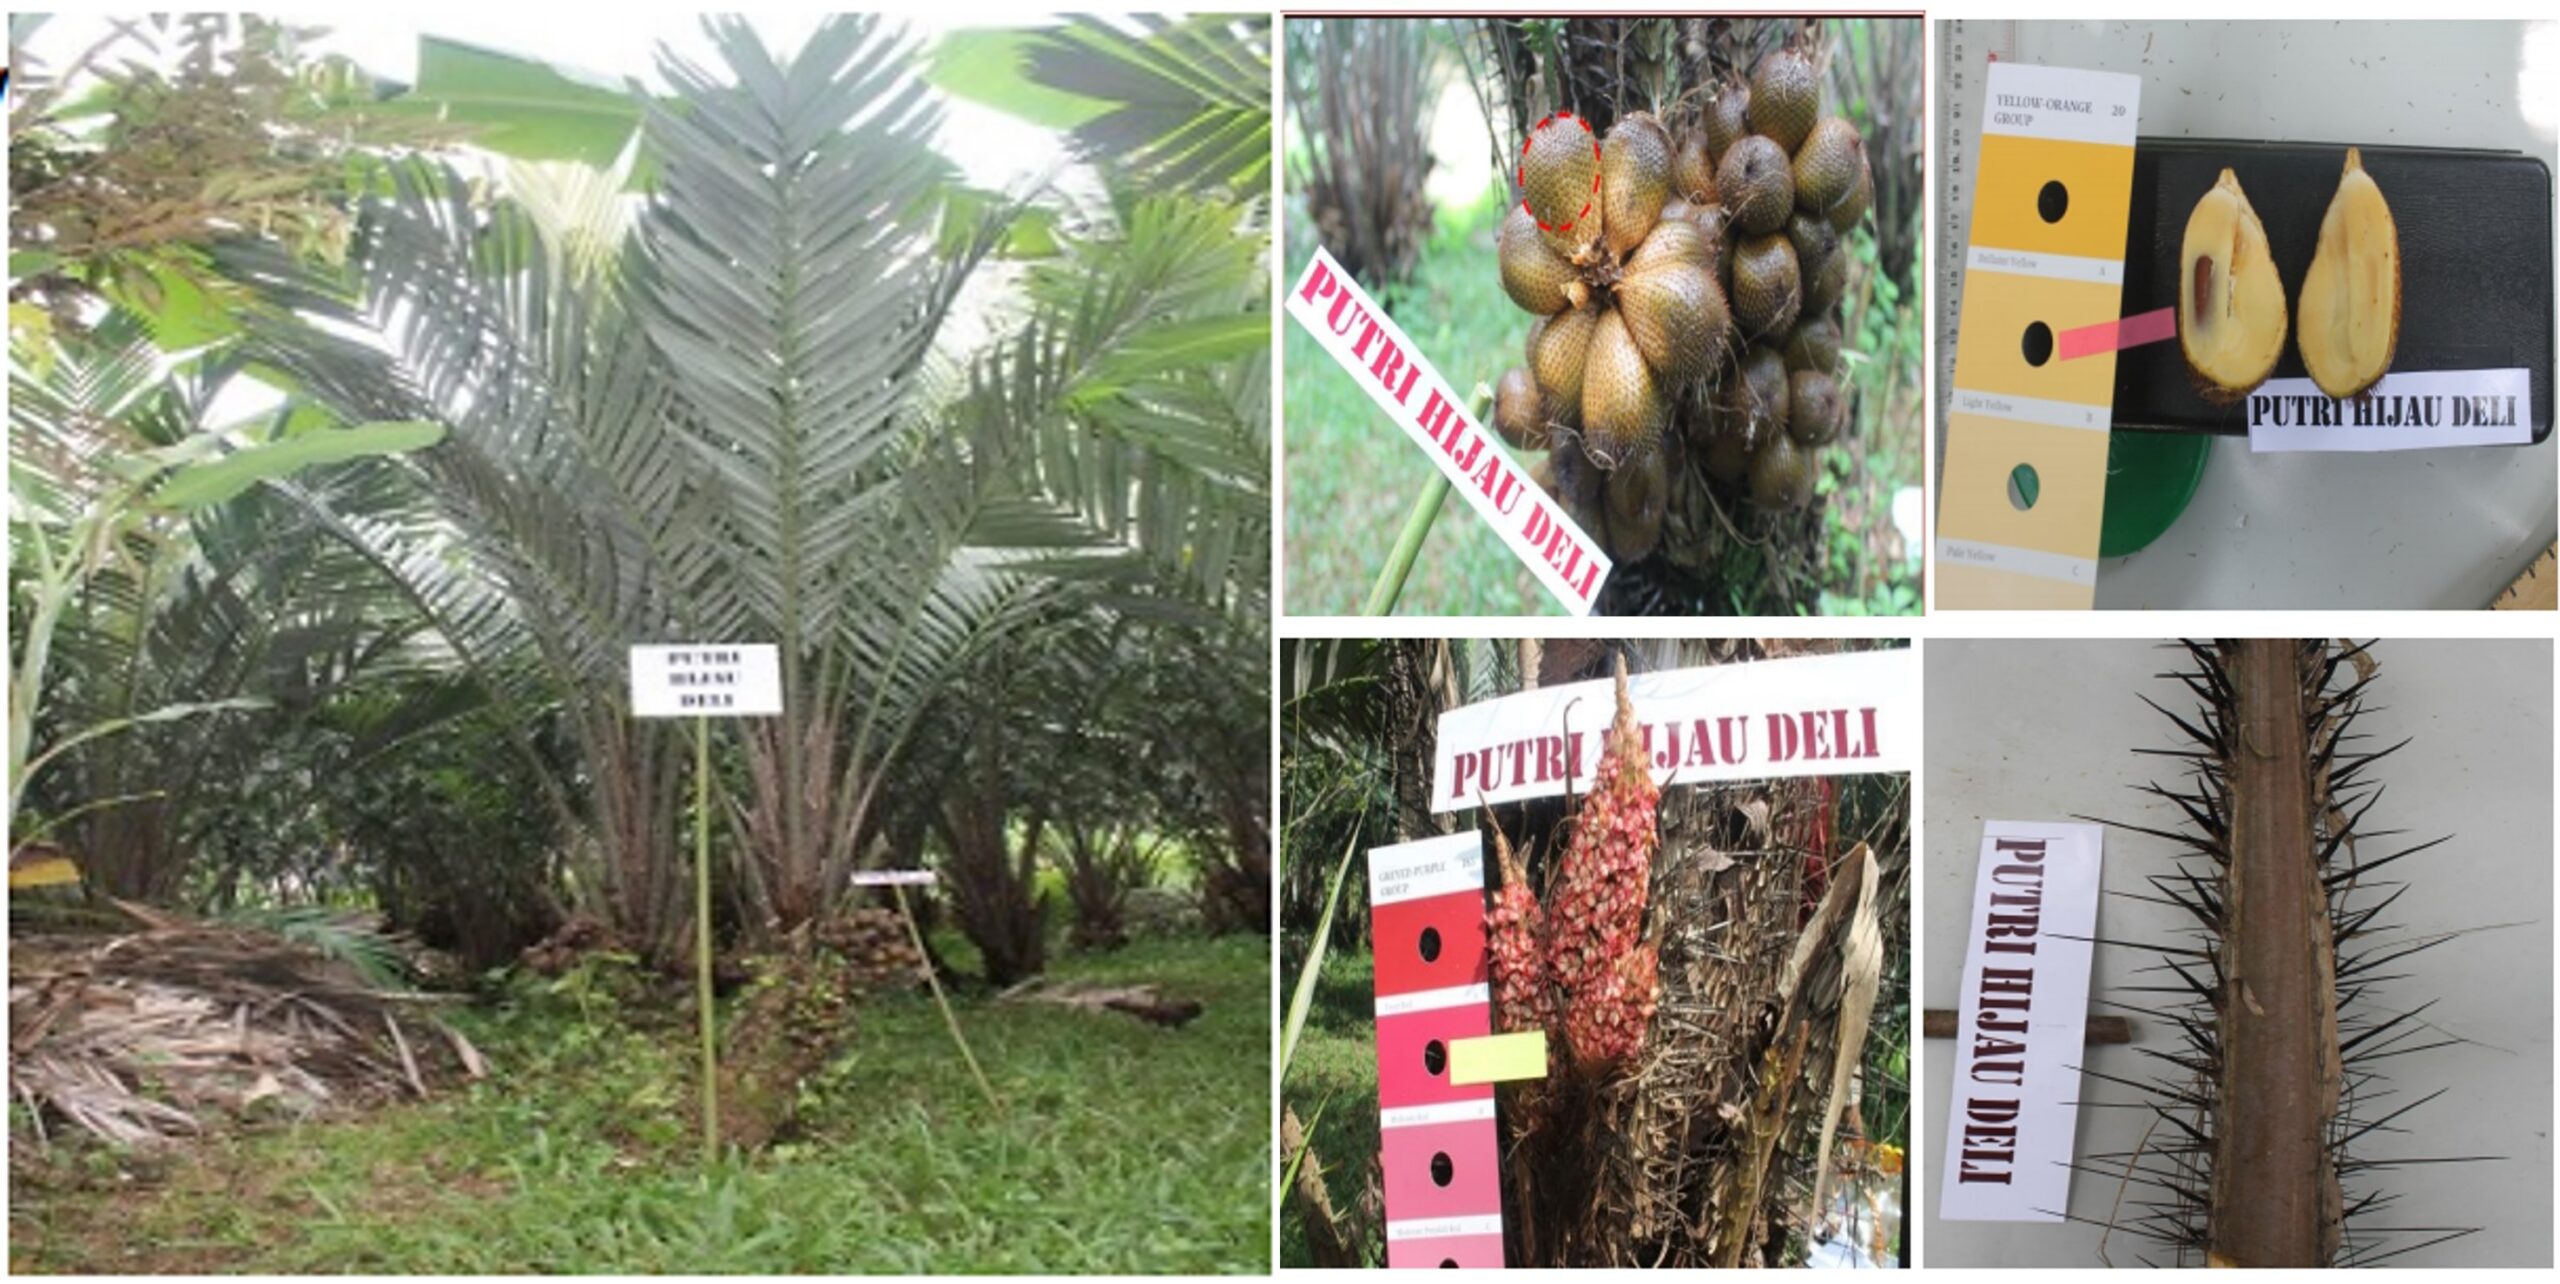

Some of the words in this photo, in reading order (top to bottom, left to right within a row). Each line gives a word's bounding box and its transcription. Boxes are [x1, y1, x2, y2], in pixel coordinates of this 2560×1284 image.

[1994, 112, 2034, 126] GROUP
[1997, 94, 2093, 114] YELLOW-ORANGE
[2112, 105, 2126, 117] 20
[1300, 259, 1422, 407] PUTRI
[1416, 388, 1526, 516] HIJAU
[1521, 502, 1601, 601] DELI
[2252, 395, 2344, 427] PUTRI
[2353, 395, 2443, 428] HIJAU
[2452, 395, 2517, 427] DELI
[1452, 731, 1584, 798] PUTRI
[1602, 715, 1749, 770] IJAU
[1767, 707, 1881, 763] DELI
[1984, 838, 2047, 956] PUTRI
[1970, 966, 2034, 1086] HIJAU
[1959, 1098, 2021, 1185] DELI
